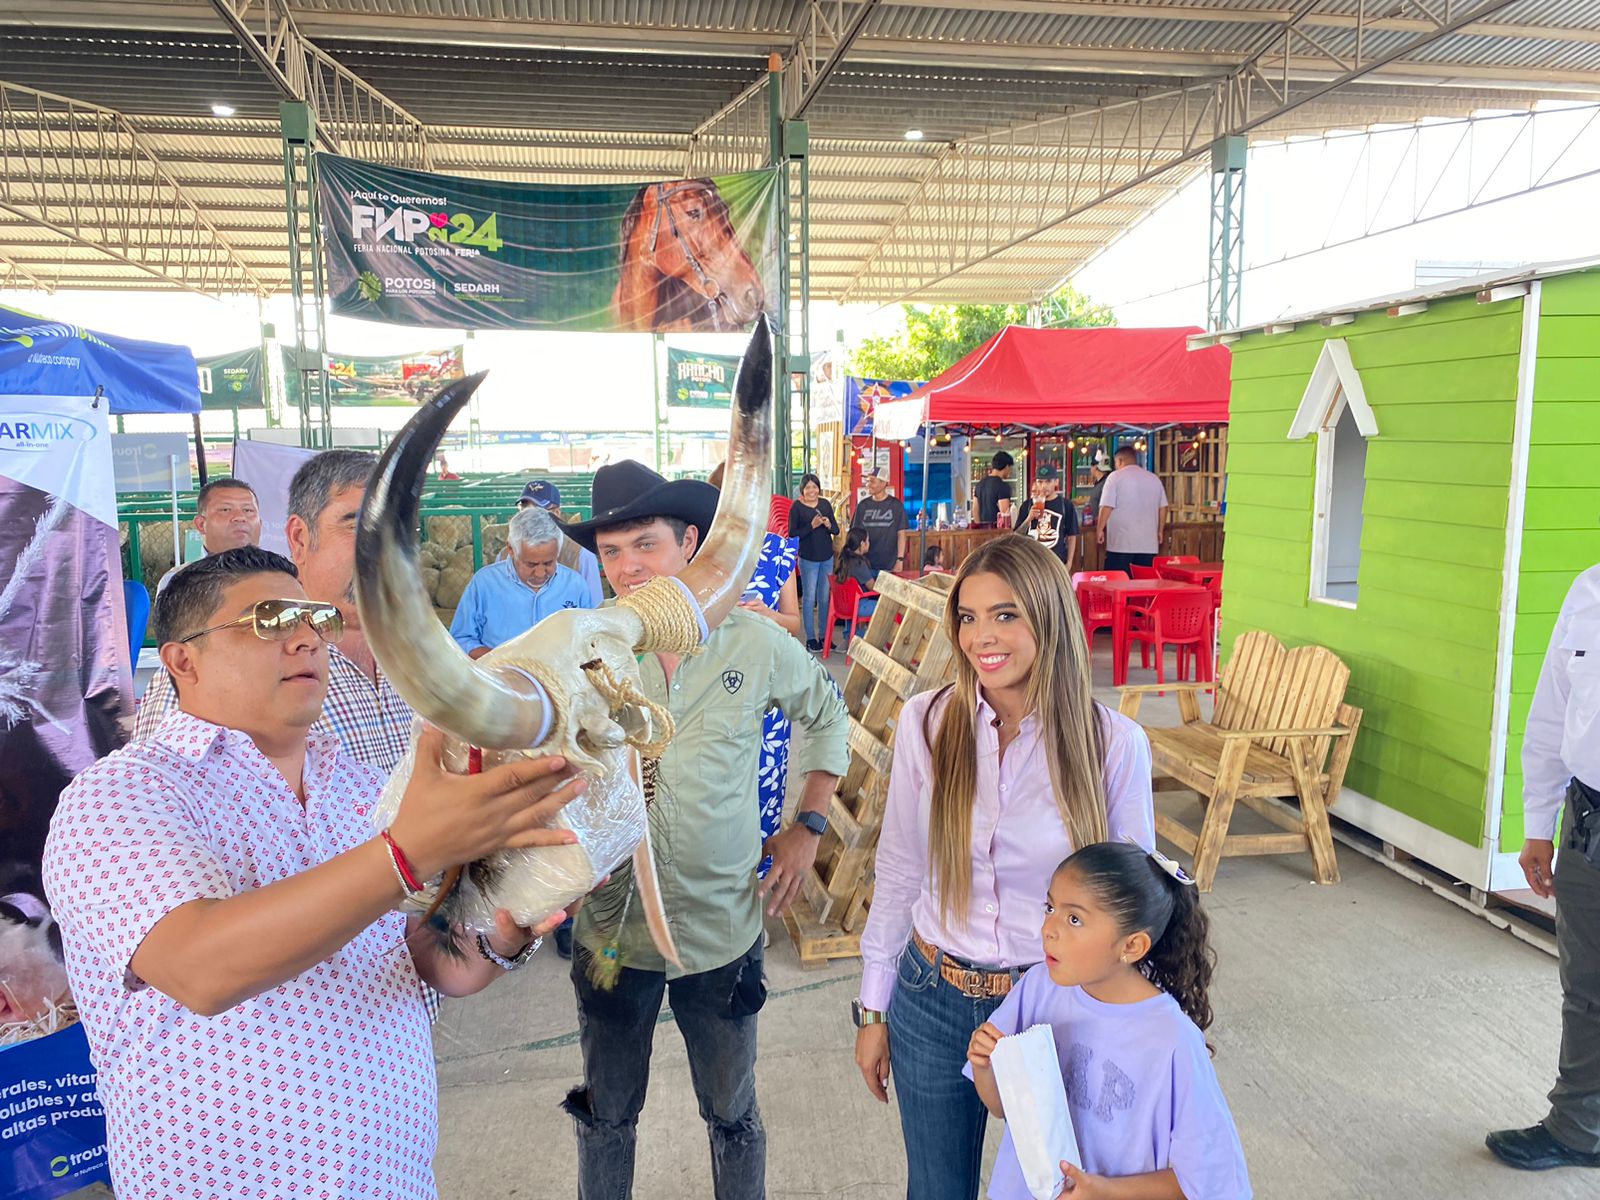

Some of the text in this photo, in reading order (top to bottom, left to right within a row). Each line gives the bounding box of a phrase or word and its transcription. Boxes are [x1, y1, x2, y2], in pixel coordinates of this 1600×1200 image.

[378, 192, 390, 201] te
[391, 194, 447, 206] Queremos!
[353, 244, 374, 253] FERIA
[376, 245, 413, 255] NACIONAL
[414, 246, 450, 257] POTOSINA
[454, 283, 500, 293] SEDARH
[863, 508, 893, 520] FILA
[0, 1079, 52, 1099] rales,
[0, 1095, 64, 1120] olubles
[66, 1093, 77, 1107] y
[1, 1106, 106, 1139] altas produ
